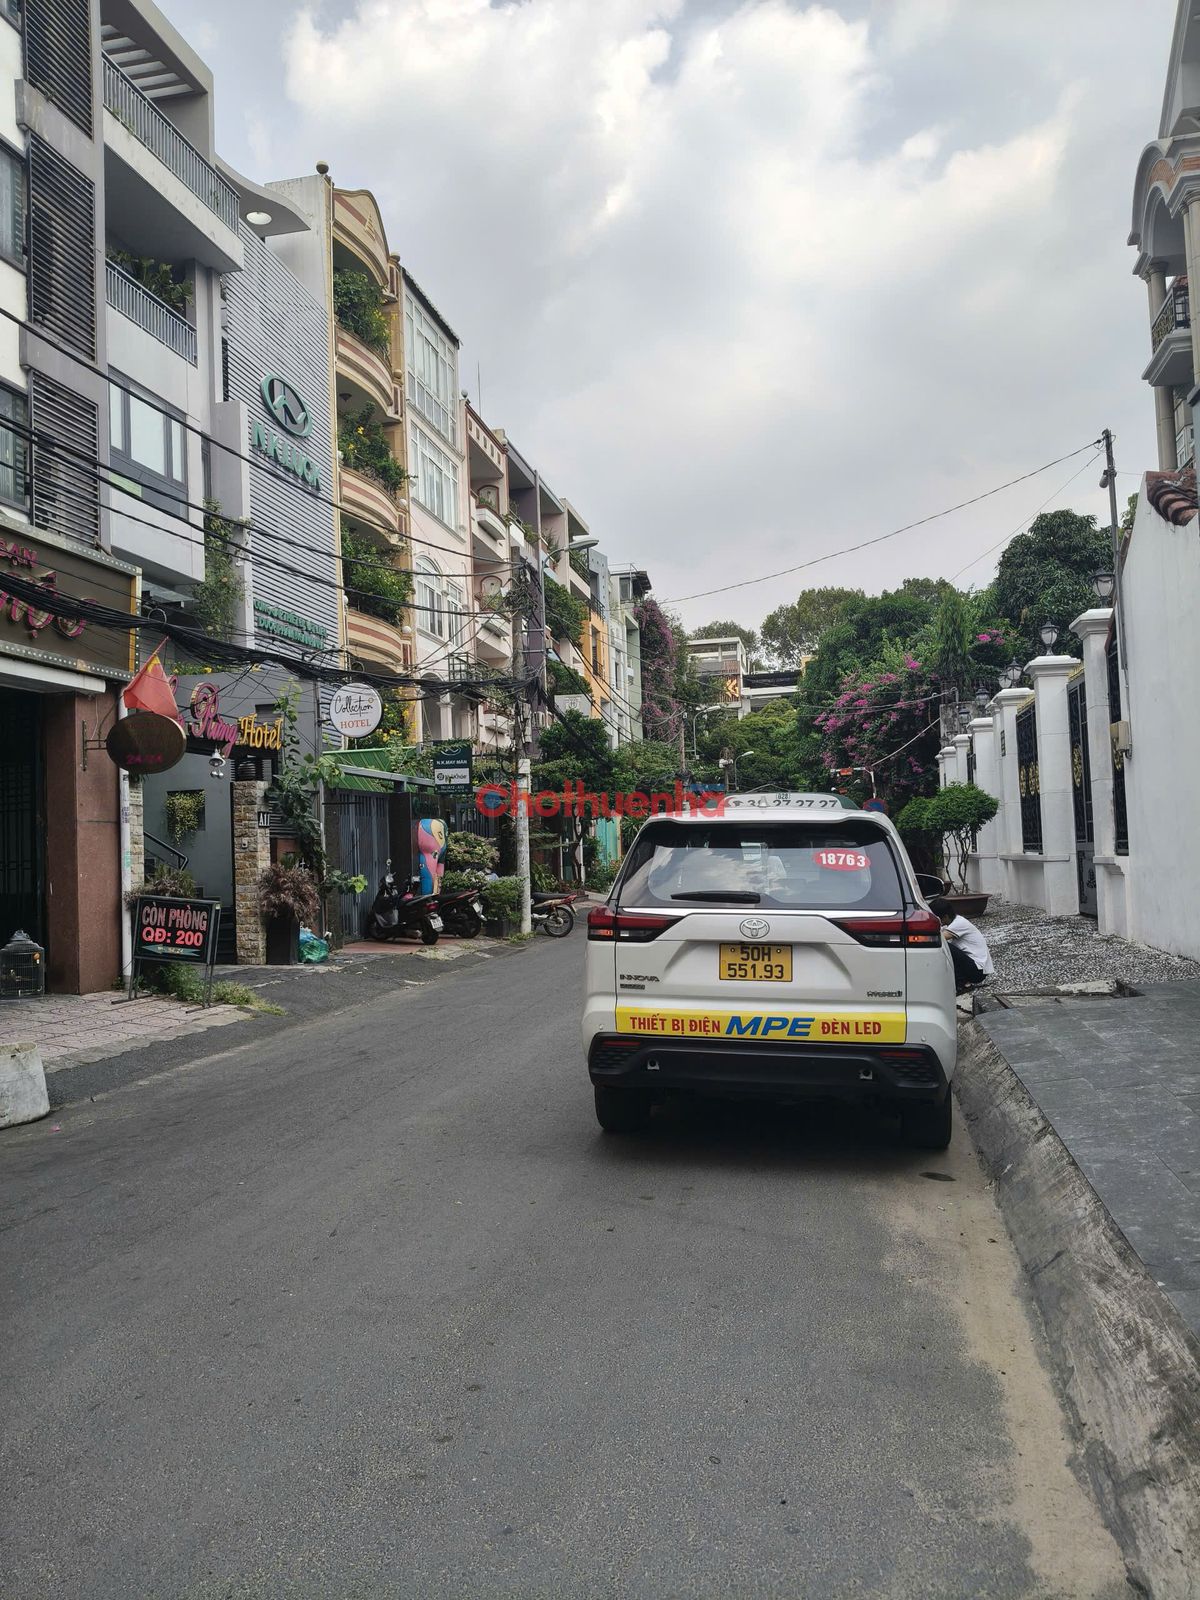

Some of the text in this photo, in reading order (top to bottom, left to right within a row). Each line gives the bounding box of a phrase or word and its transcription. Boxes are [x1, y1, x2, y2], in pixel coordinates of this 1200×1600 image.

[335, 695, 373, 717] Collection
[240, 713, 284, 751] Hotel
[340, 719, 371, 729] HOTEL
[820, 853, 866, 867] 18763
[142, 902, 208, 931] CÒN PHÒNG
[142, 927, 204, 946] QĐ: 200
[740, 946, 771, 962] 50H
[620, 974, 660, 982] INNOVA
[727, 963, 784, 979] 551.93
[630, 1013, 882, 1037] THIẾT BỊ ĐIỆN MPE ĐÈN LED
